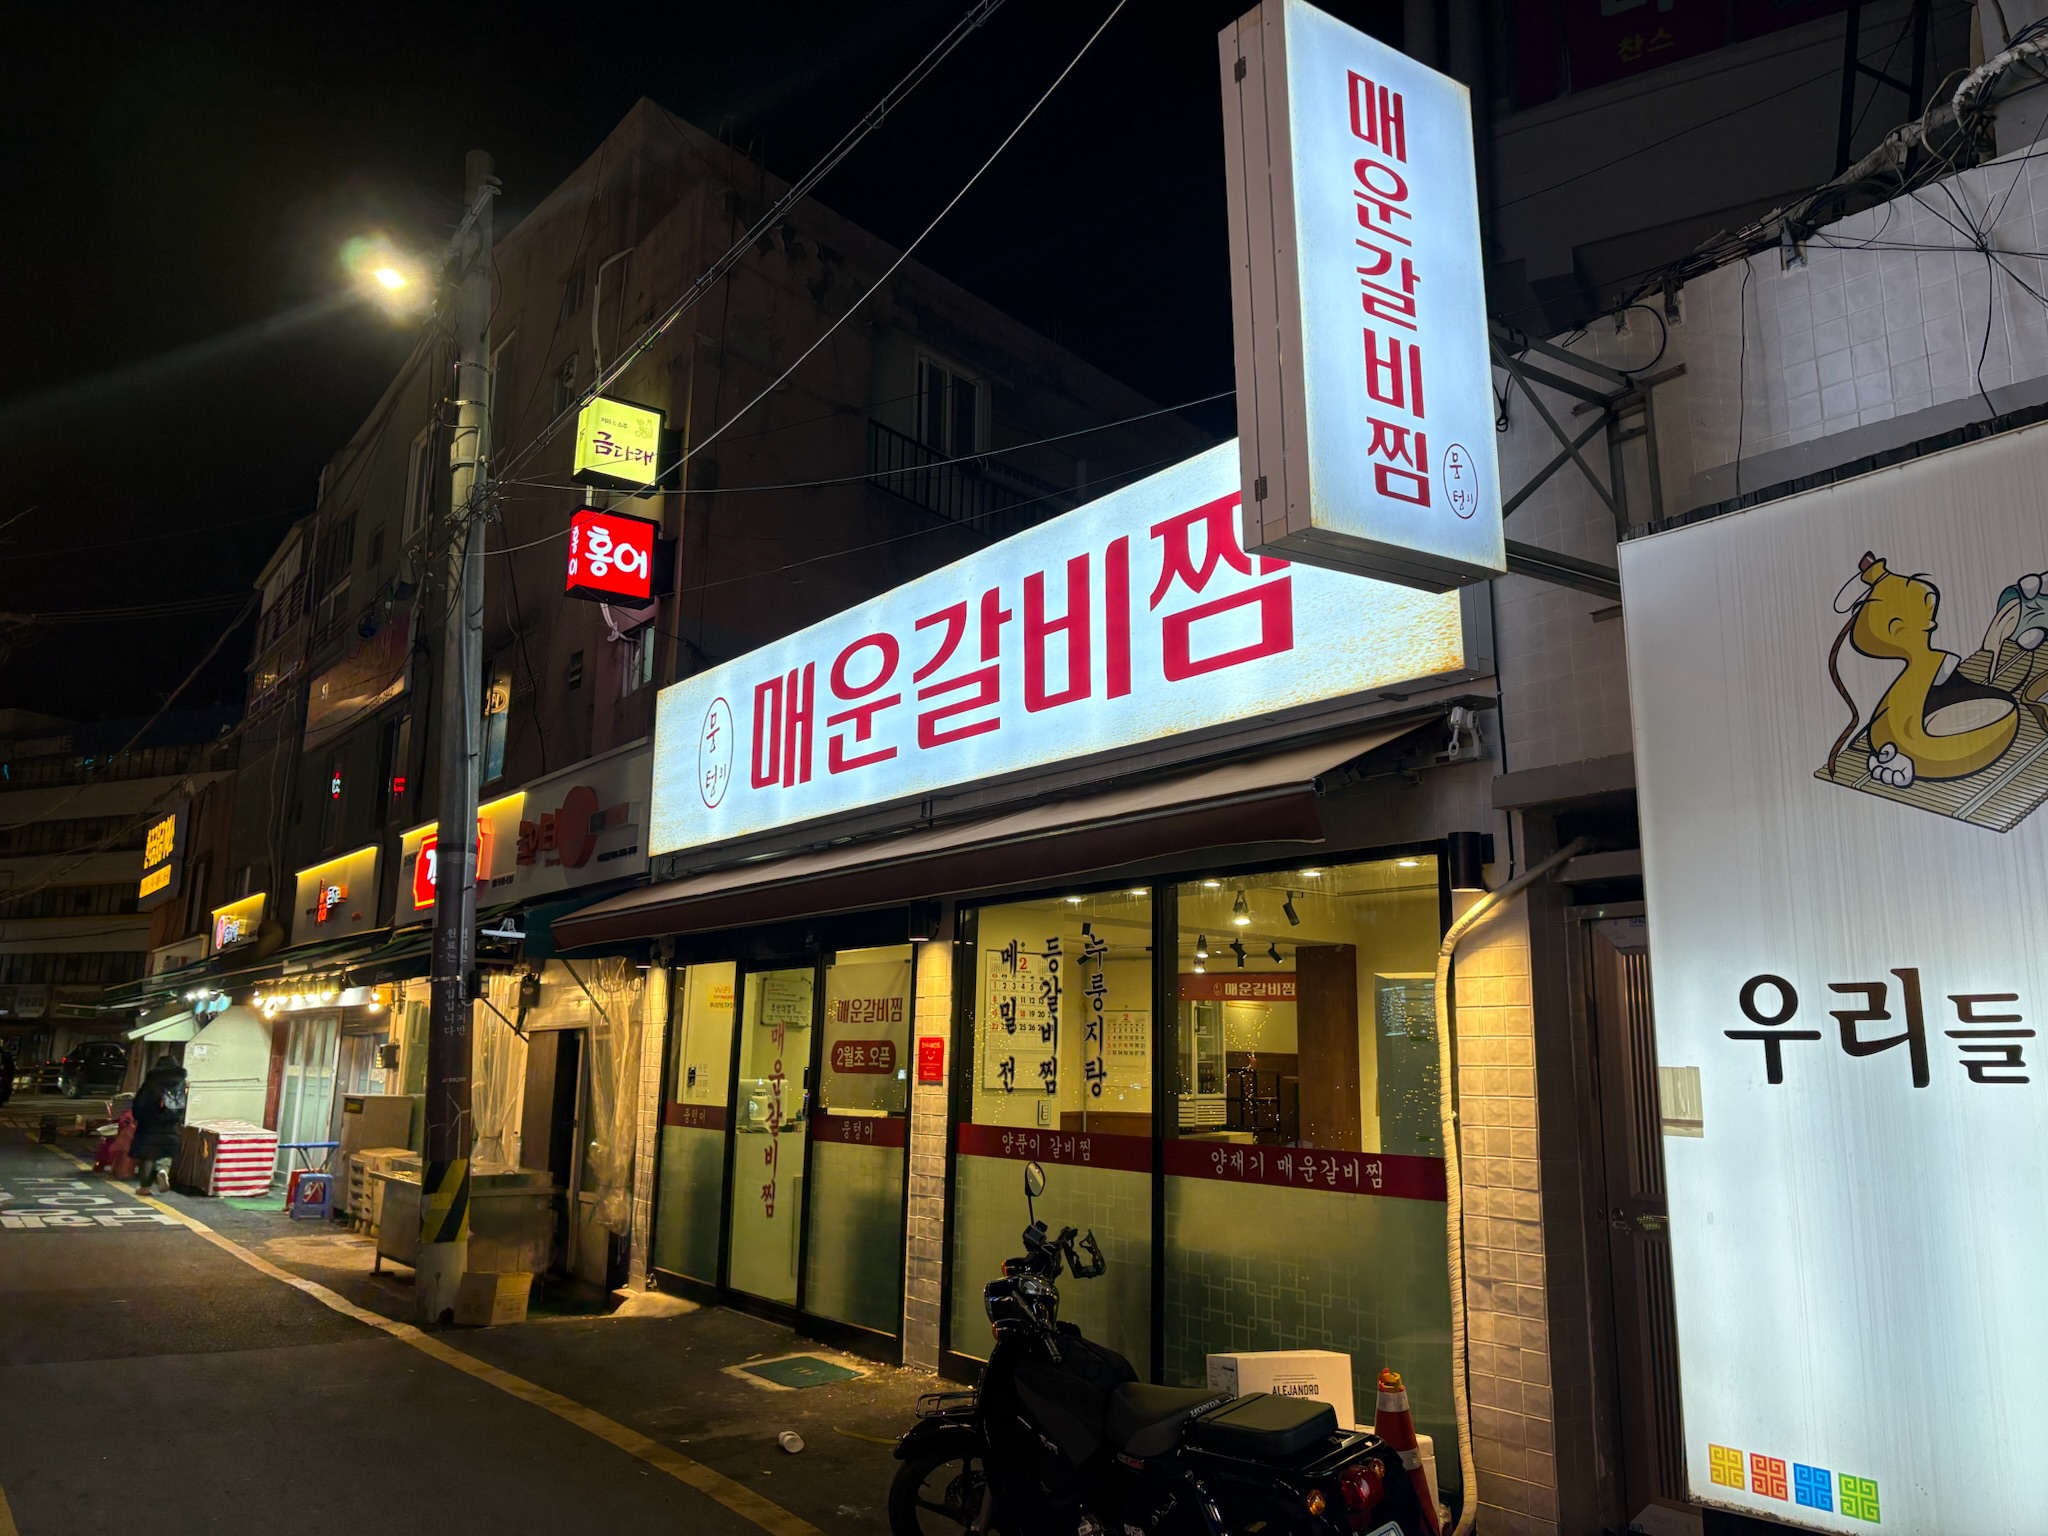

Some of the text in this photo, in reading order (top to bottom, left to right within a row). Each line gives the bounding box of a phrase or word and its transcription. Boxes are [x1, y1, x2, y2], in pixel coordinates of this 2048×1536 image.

[1617, 27, 1676, 63] 찬스
[1346, 69, 1431, 509] 매운갈비찜
[593, 431, 655, 466] 금다래
[568, 525, 579, 576] 홍어
[584, 525, 648, 580] 홍어
[750, 492, 1296, 790] 매운갈비찜
[1019, 957, 1027, 970] 2
[1224, 982, 1296, 996] 매운갈비찜
[837, 997, 904, 1024] 매운갈비찜
[998, 939, 1017, 1092] 메밀전
[1038, 937, 1062, 1094] 등갈비찜
[1084, 934, 1108, 1097] 누룽지탕
[1723, 967, 2037, 1088] 우리들
[837, 1046, 890, 1068] 2월초 오픈
[760, 1020, 787, 1220] 매운갈비찜
[842, 1120, 875, 1142] 뭉텅이
[1001, 1131, 1092, 1162] 양푼이 갈비찜
[1210, 1148, 1384, 1190] 양재기 매운갈비찜
[1189, 1398, 1222, 1418] HONDA
[1272, 1384, 1319, 1396] ALEJANDRO
